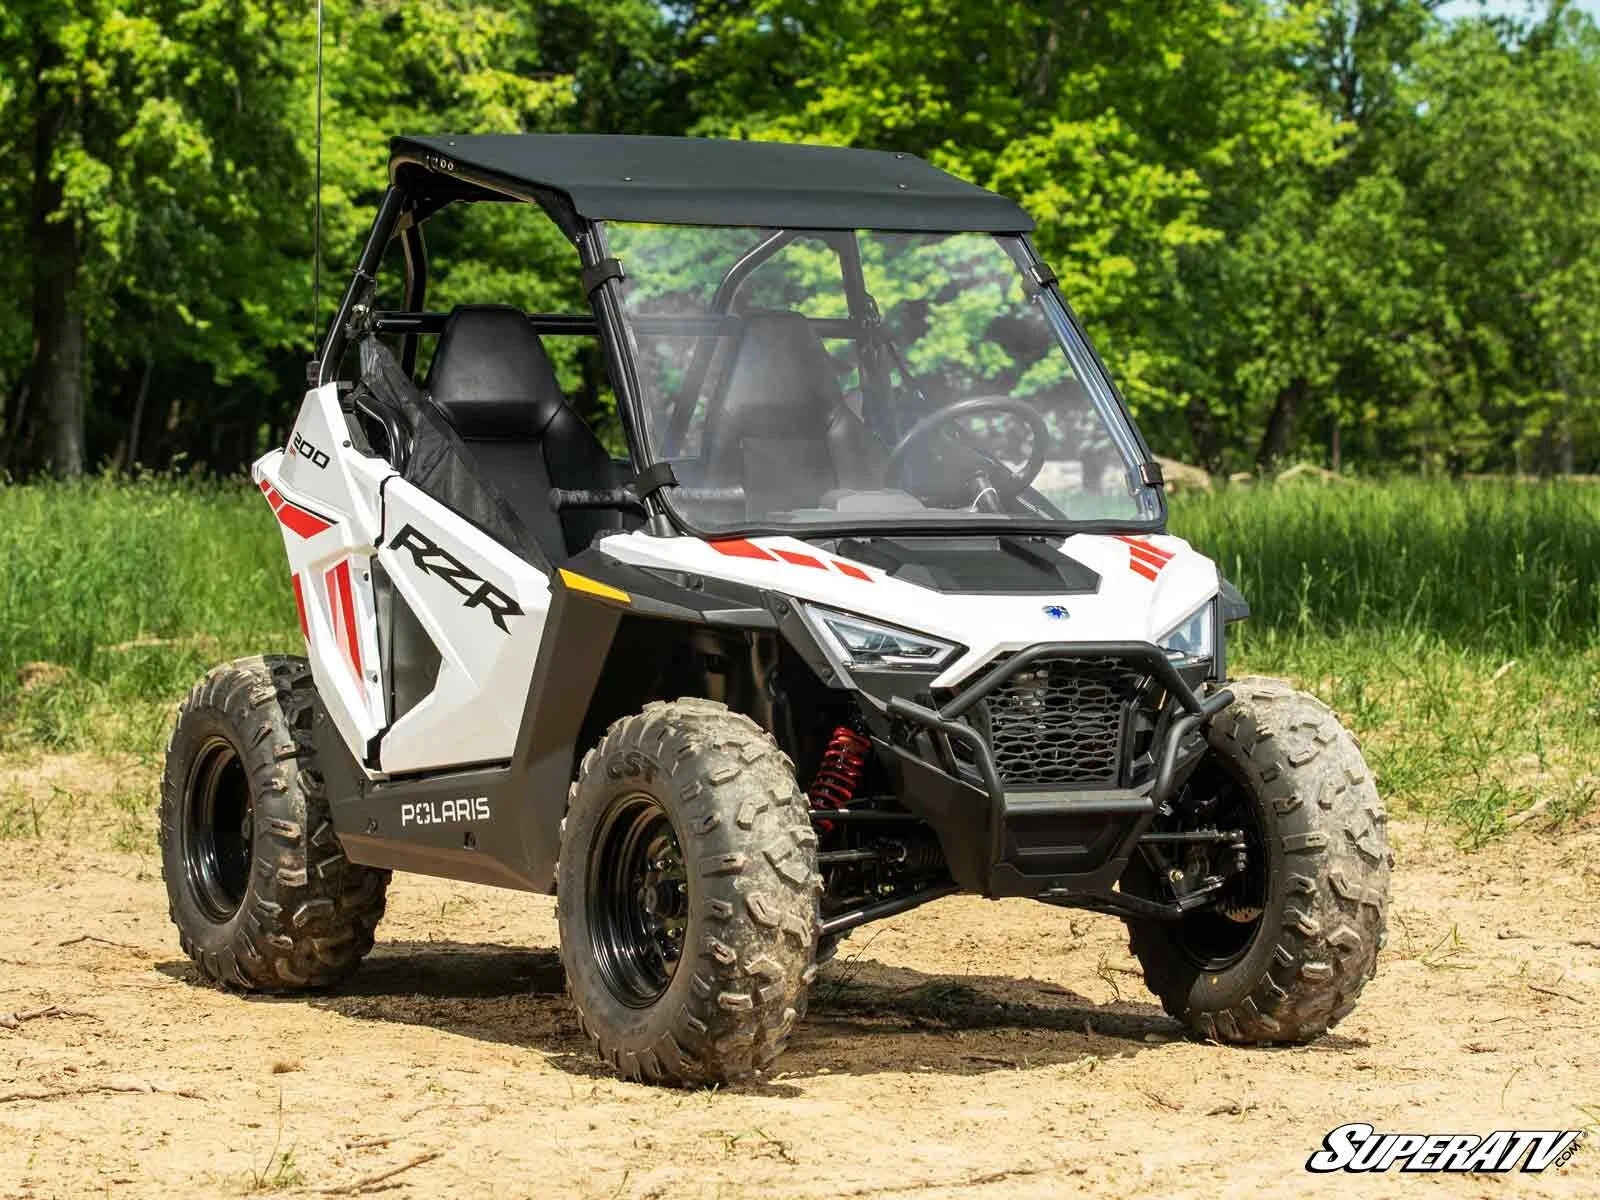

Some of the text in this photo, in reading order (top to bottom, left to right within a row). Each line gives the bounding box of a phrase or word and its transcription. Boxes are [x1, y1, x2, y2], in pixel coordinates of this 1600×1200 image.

[293, 431, 330, 469] 200
[388, 523, 526, 636] RZR
[401, 797, 490, 827] POLARIS
